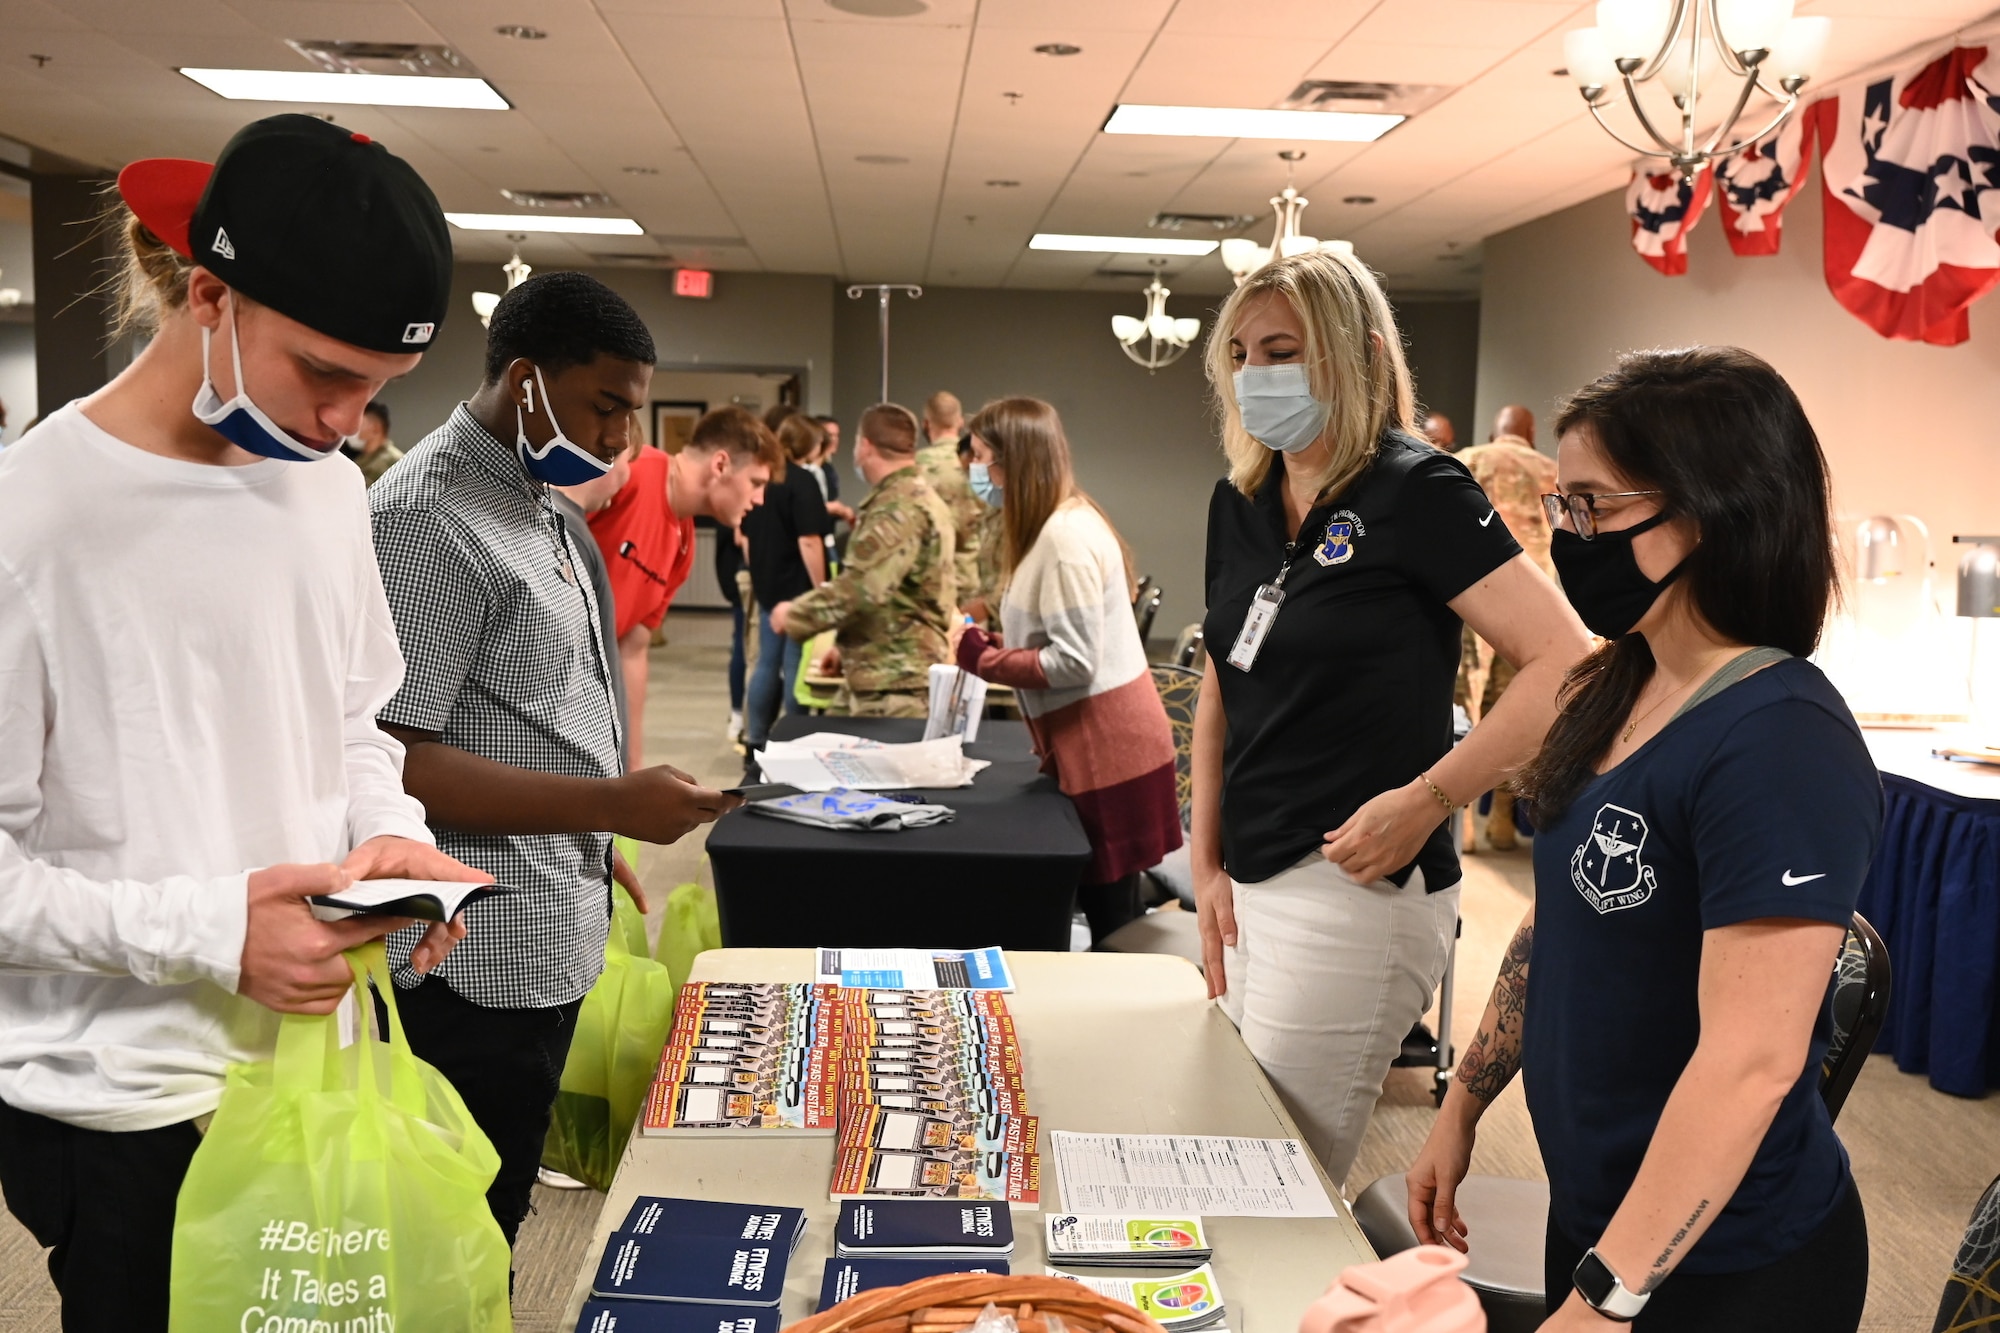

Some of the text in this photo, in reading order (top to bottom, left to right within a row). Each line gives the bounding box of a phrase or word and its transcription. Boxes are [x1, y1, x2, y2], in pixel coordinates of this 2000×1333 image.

[1338, 509, 1367, 537] PROMOTION
[1584, 887, 1615, 911] AIRLIFT
[1617, 888, 1645, 905] WING
[825, 1084, 835, 1117] NUTRITION
[1029, 1156, 1040, 1191] NUTRITION
[961, 1208, 975, 1234] JOURNAL
[975, 1206, 994, 1237] FITNESS
[1652, 1247, 1674, 1268] VENI
[1668, 1228, 1688, 1247] VIDI
[1685, 1199, 1710, 1229] AMAVI
[728, 1250, 750, 1287] JOURNAL
[743, 1248, 770, 1292] FITNESS
[260, 1267, 387, 1307] It Takes a
[240, 1306, 397, 1333] Community
